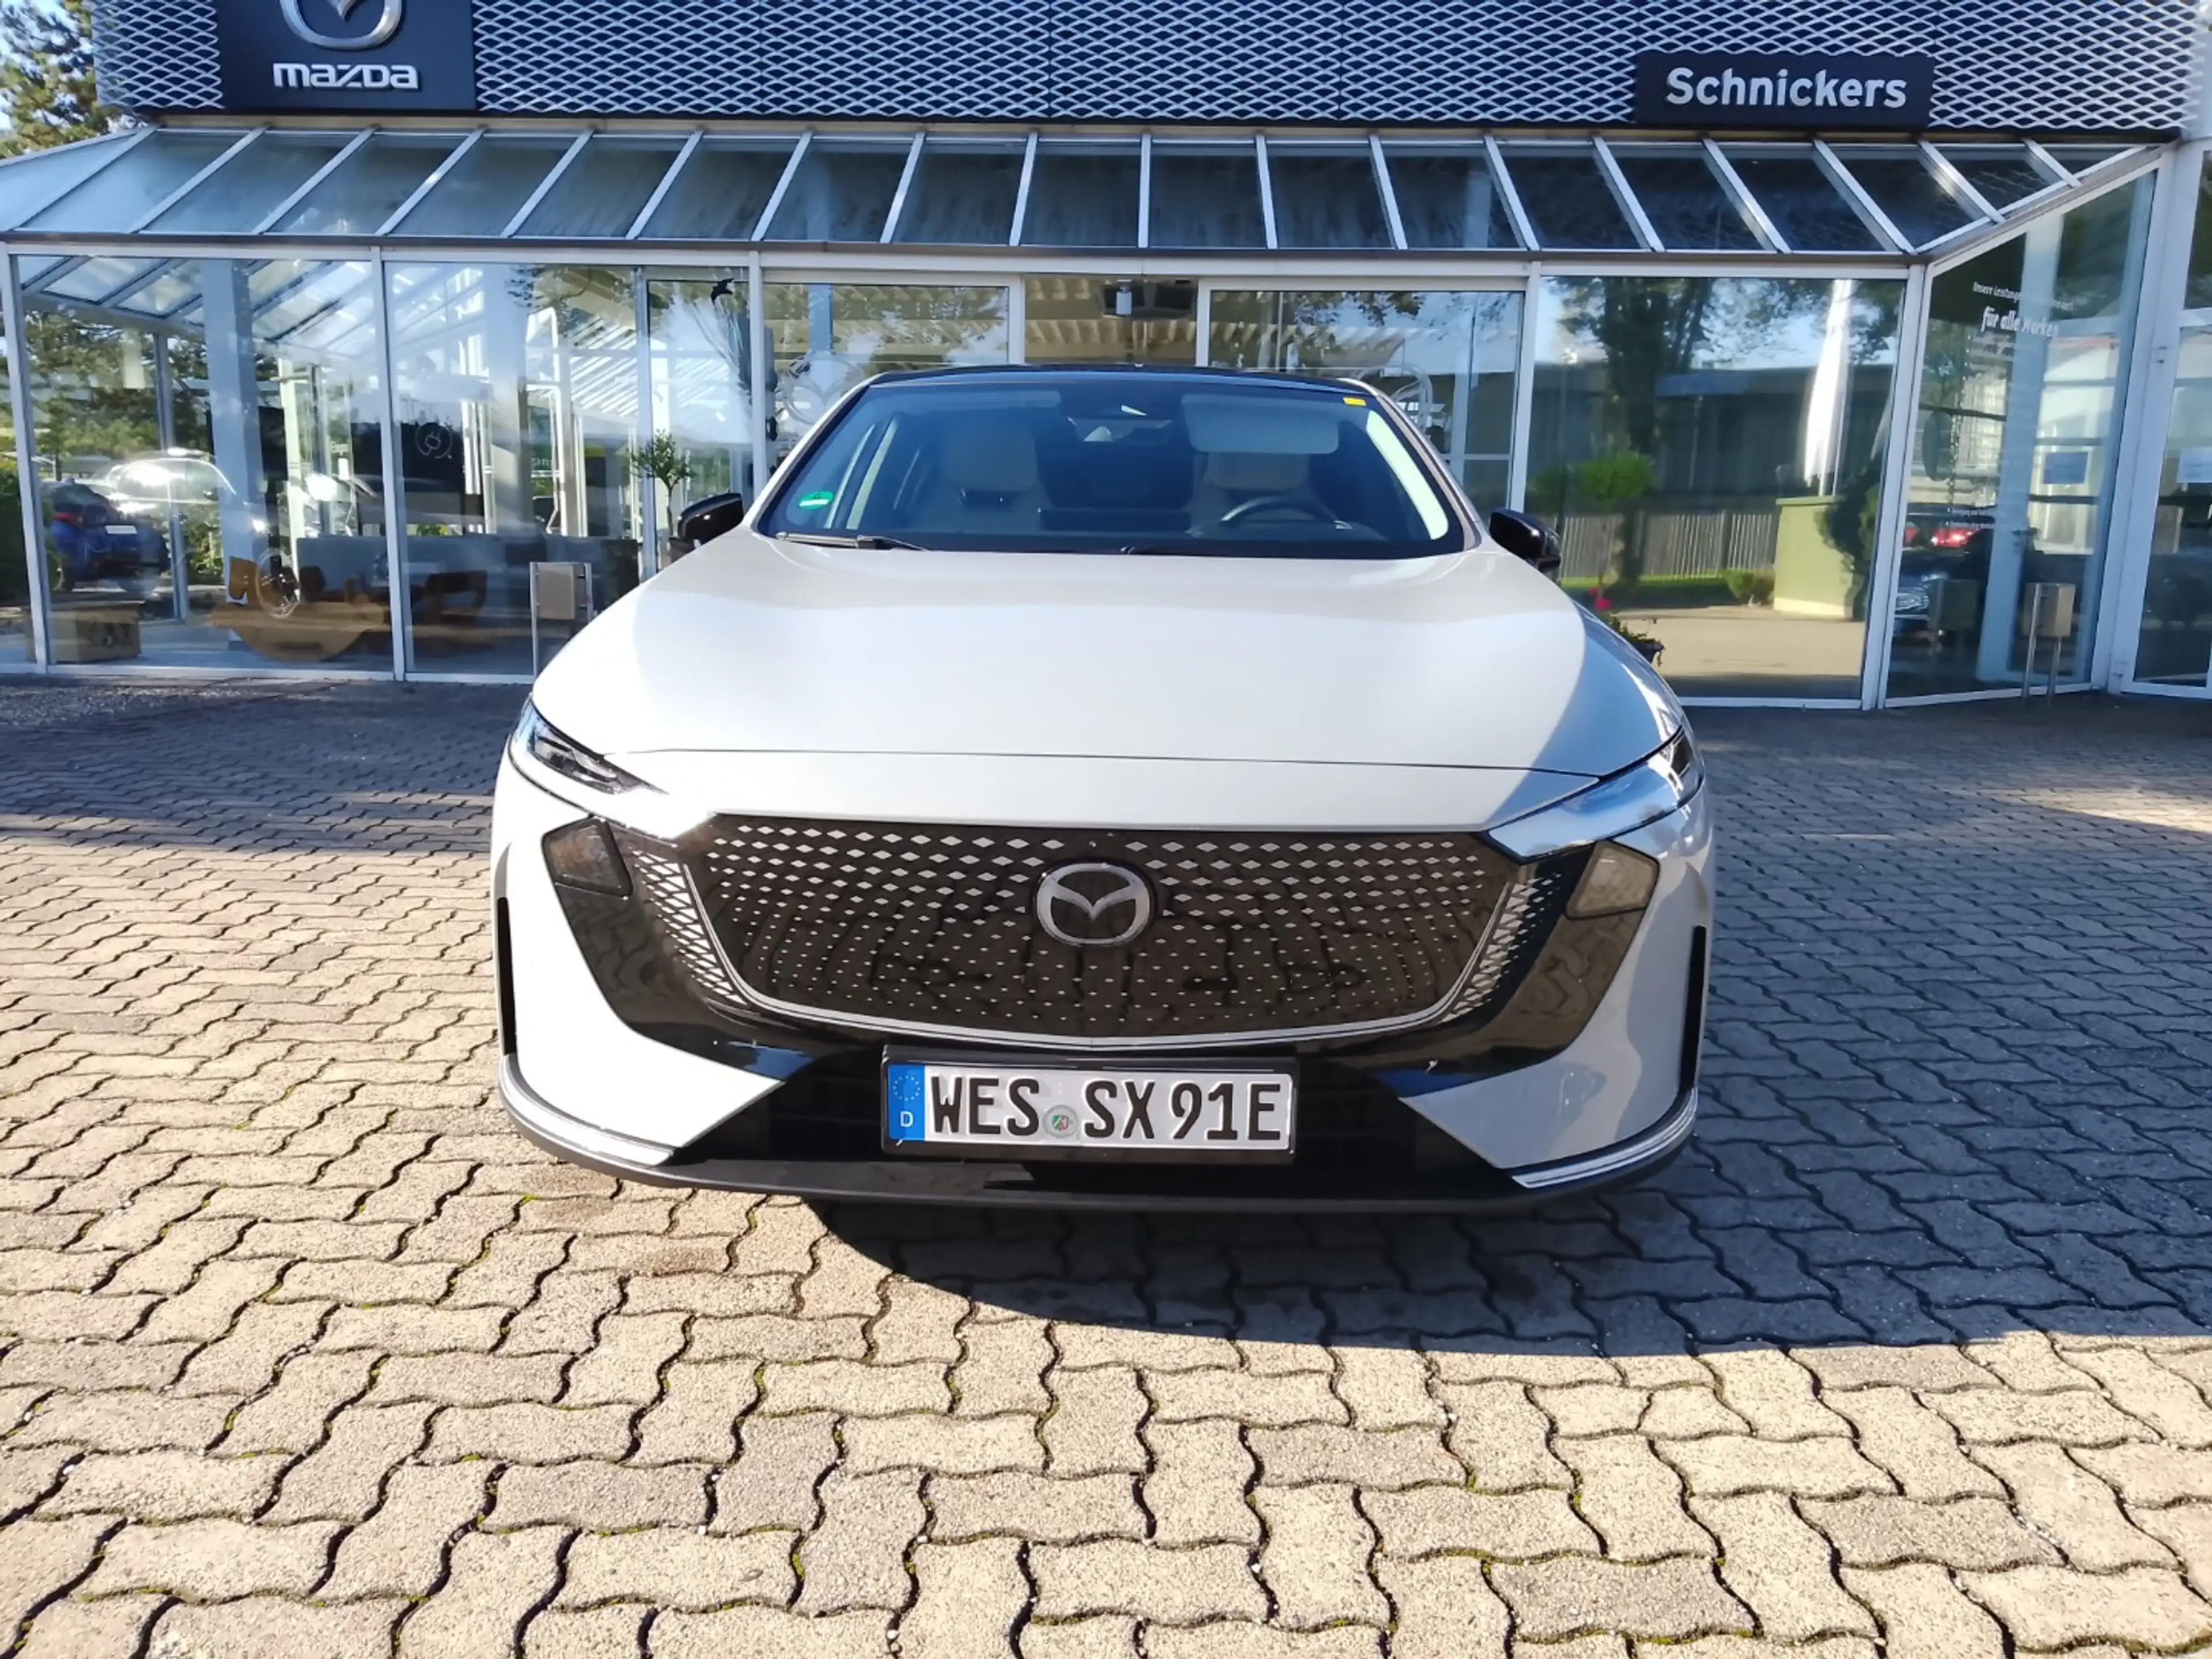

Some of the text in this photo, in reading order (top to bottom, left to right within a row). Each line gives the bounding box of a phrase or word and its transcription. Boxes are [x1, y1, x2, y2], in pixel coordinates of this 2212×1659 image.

[1666, 67, 1907, 108] Schnickers
[2000, 310, 2021, 331] alle
[900, 1111, 914, 1127] D
[930, 1076, 1040, 1137] WES
[1084, 1080, 1156, 1139] SX
